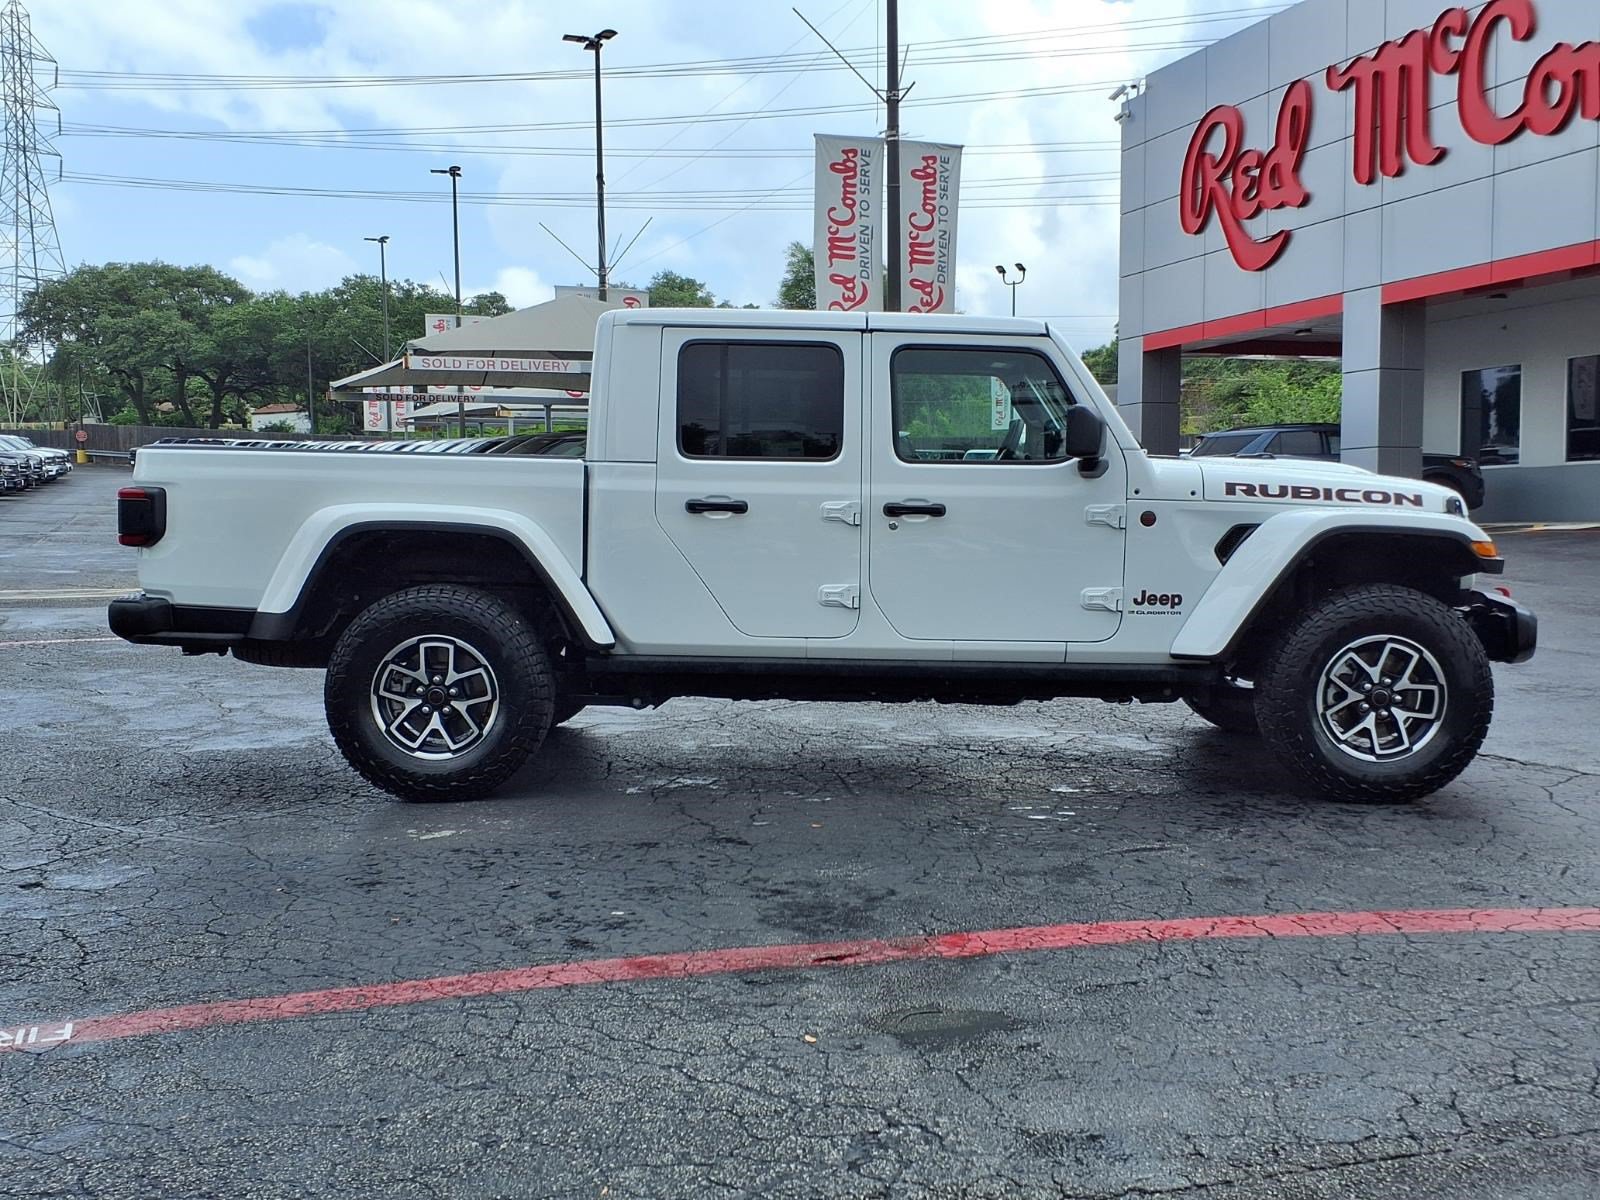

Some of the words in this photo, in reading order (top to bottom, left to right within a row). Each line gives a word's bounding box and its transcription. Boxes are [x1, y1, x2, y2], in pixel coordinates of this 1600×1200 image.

[859, 148, 872, 196] SERVE
[938, 155, 950, 201] SERVE
[1180, 79, 1313, 271] Red
[827, 147, 859, 268] McCombs
[859, 199, 871, 219] TO
[908, 155, 938, 274] McCombs
[937, 207, 949, 227] TO
[859, 225, 871, 281] DRIVEN
[936, 229, 949, 285] DRIVEN
[421, 358, 462, 369] SOLD
[466, 359, 496, 370] FOR
[500, 360, 570, 371] DELIVERY
[375, 393, 403, 402] SOLD
[405, 394, 426, 402] FOR
[429, 394, 477, 403] DELIVERY
[1224, 481, 1424, 507] RUBICON
[1133, 590, 1183, 609] Jeep
